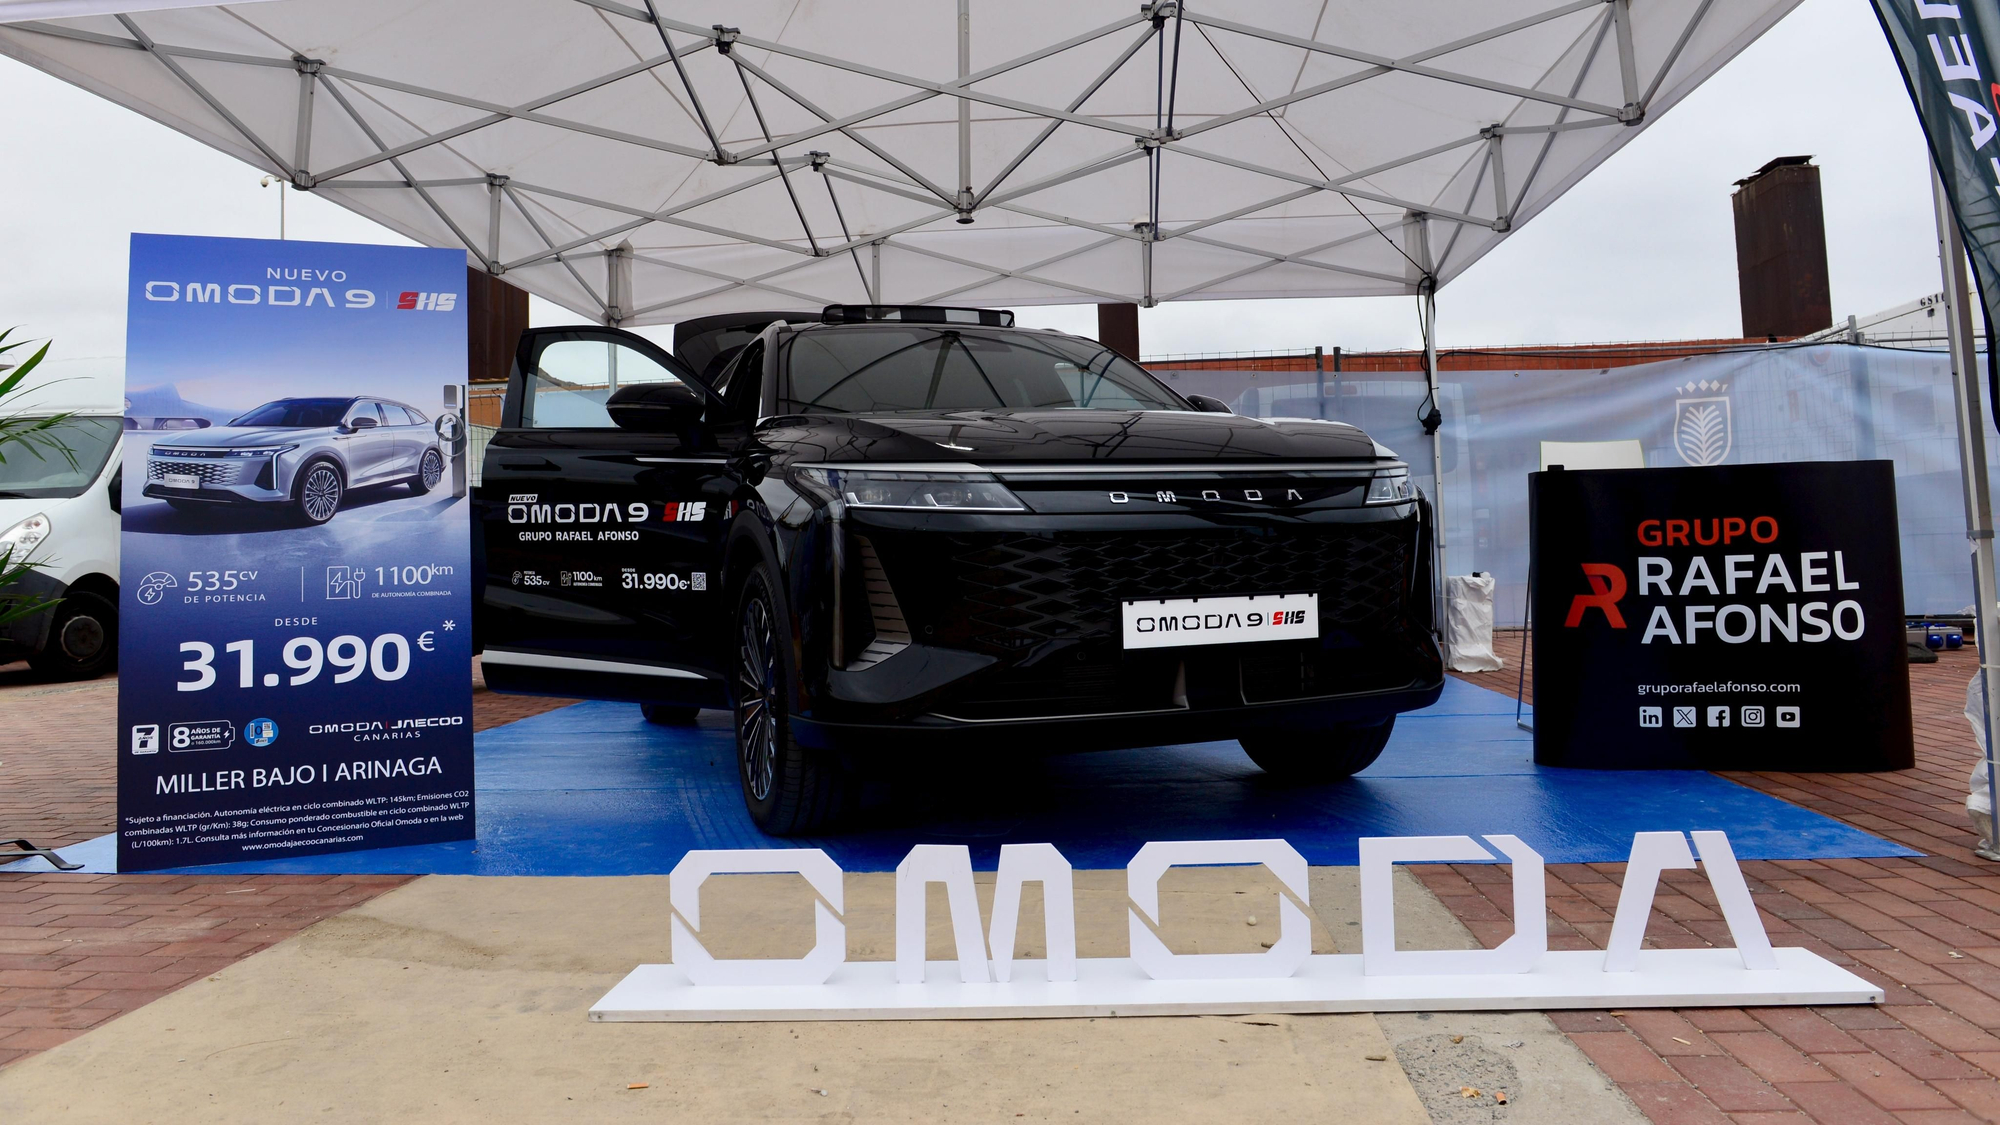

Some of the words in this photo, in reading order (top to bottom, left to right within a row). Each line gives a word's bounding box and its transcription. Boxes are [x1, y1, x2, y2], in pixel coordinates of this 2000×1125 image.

[266, 267, 347, 282] NUEVO
[145, 281, 336, 308] OMODA
[396, 291, 457, 312] SHS
[1108, 489, 1303, 503] OMODA
[508, 503, 622, 523] OMODA
[663, 501, 707, 522] SHS
[518, 531, 552, 541] GRUPO
[555, 531, 594, 541] RAFAEL
[597, 531, 639, 541] AFONSO
[1637, 516, 1779, 547] GRUPO
[1637, 550, 1860, 596] RAFAEL
[184, 595, 199, 604] DE
[205, 593, 266, 603] POTENCIA
[274, 616, 318, 627] DESDE
[1136, 613, 1242, 633] OMODA
[1272, 610, 1305, 625] SHS
[1641, 600, 1865, 645] AFONSO
[1638, 681, 1800, 696] gruporafaelafonso.com
[309, 721, 383, 734] OMODA
[391, 716, 463, 729] JAECOO
[353, 730, 421, 742] CANARIAS
[172, 726, 190, 748] 8
[156, 769, 245, 795] MILLER
[252, 765, 316, 788] BAJO
[334, 756, 443, 782] ARINAGA
[213, 807, 257, 817] Autonomía
[259, 804, 290, 814] eléctrica
[303, 802, 321, 810] ciclo
[322, 799, 364, 809] combinado
[417, 792, 453, 801] Emisiones
[454, 790, 469, 798] CO2
[124, 827, 174, 837] combinadas
[175, 825, 198, 833] WLTP
[250, 818, 287, 827] Consumo
[288, 814, 330, 825] ponderado
[331, 809, 377, 819] combustible
[389, 806, 406, 814] ciclo
[407, 804, 448, 813] combinado
[449, 801, 470, 809] WLTP
[195, 834, 229, 844] Consulta
[231, 832, 247, 840] más
[249, 828, 295, 839] información
[317, 823, 370, 832] Concesionario
[371, 819, 394, 828] Oficial
[395, 817, 422, 826] Omoda
[448, 813, 464, 821] web
[242, 834, 364, 851] www.omodajaecoocanarias.com
[669, 829, 1779, 985] OMODA
